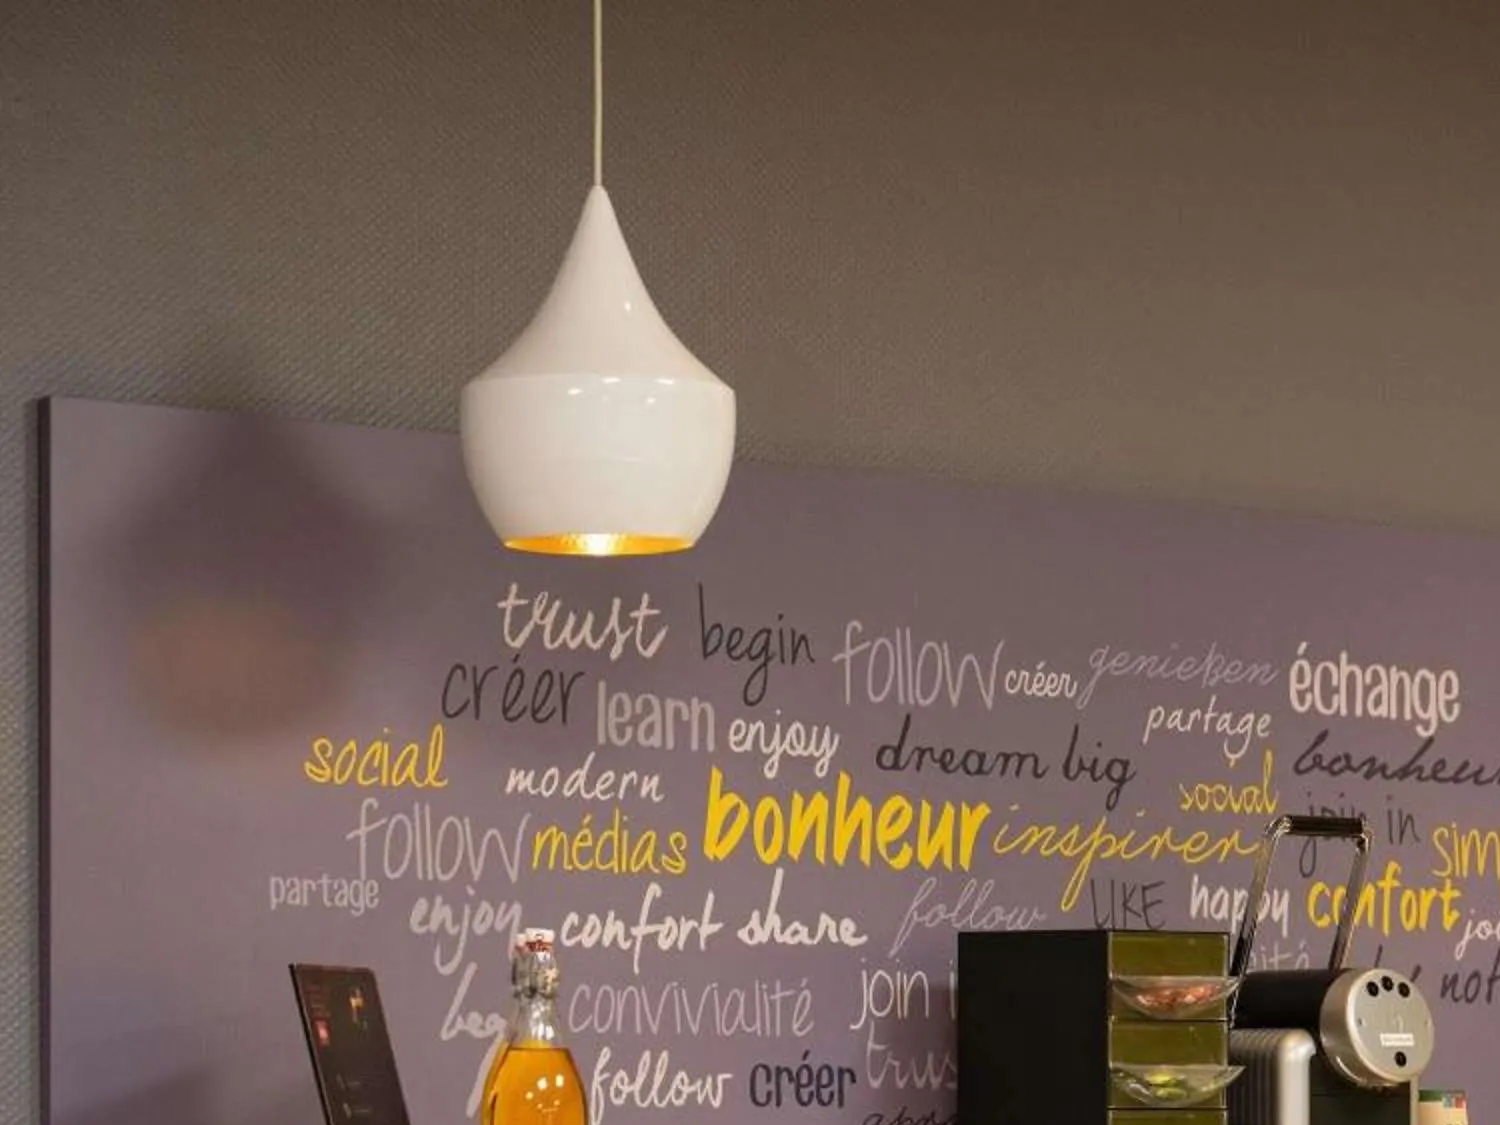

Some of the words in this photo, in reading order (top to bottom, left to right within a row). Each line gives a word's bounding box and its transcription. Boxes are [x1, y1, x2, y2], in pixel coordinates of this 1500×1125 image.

[498, 583, 669, 659] trust
[698, 584, 816, 706] begin
[441, 655, 586, 724] créer
[832, 619, 1005, 710] follow
[1004, 660, 1078, 699] créer
[1289, 641, 1462, 737] échange
[597, 681, 716, 752] learn
[727, 710, 841, 778] enjoy
[1143, 695, 1273, 760] partage
[304, 724, 448, 787] social
[506, 752, 665, 802] modern
[875, 714, 1050, 781] dream
[1062, 724, 1136, 810] big
[1179, 749, 1279, 815] social
[346, 798, 532, 884] follow
[531, 807, 688, 874] médias
[703, 767, 991, 872] bonheur
[1386, 794, 1421, 845] in
[992, 803, 1261, 913] inspirer
[269, 873, 380, 916] partage
[409, 884, 522, 976] enjoy
[560, 882, 724, 975] confort
[737, 868, 869, 947] share
[889, 877, 1047, 957] follow
[568, 978, 815, 1037] convivialité
[850, 958, 931, 1029] join
[750, 1050, 857, 1108] créer
[866, 1020, 958, 1091] trus
